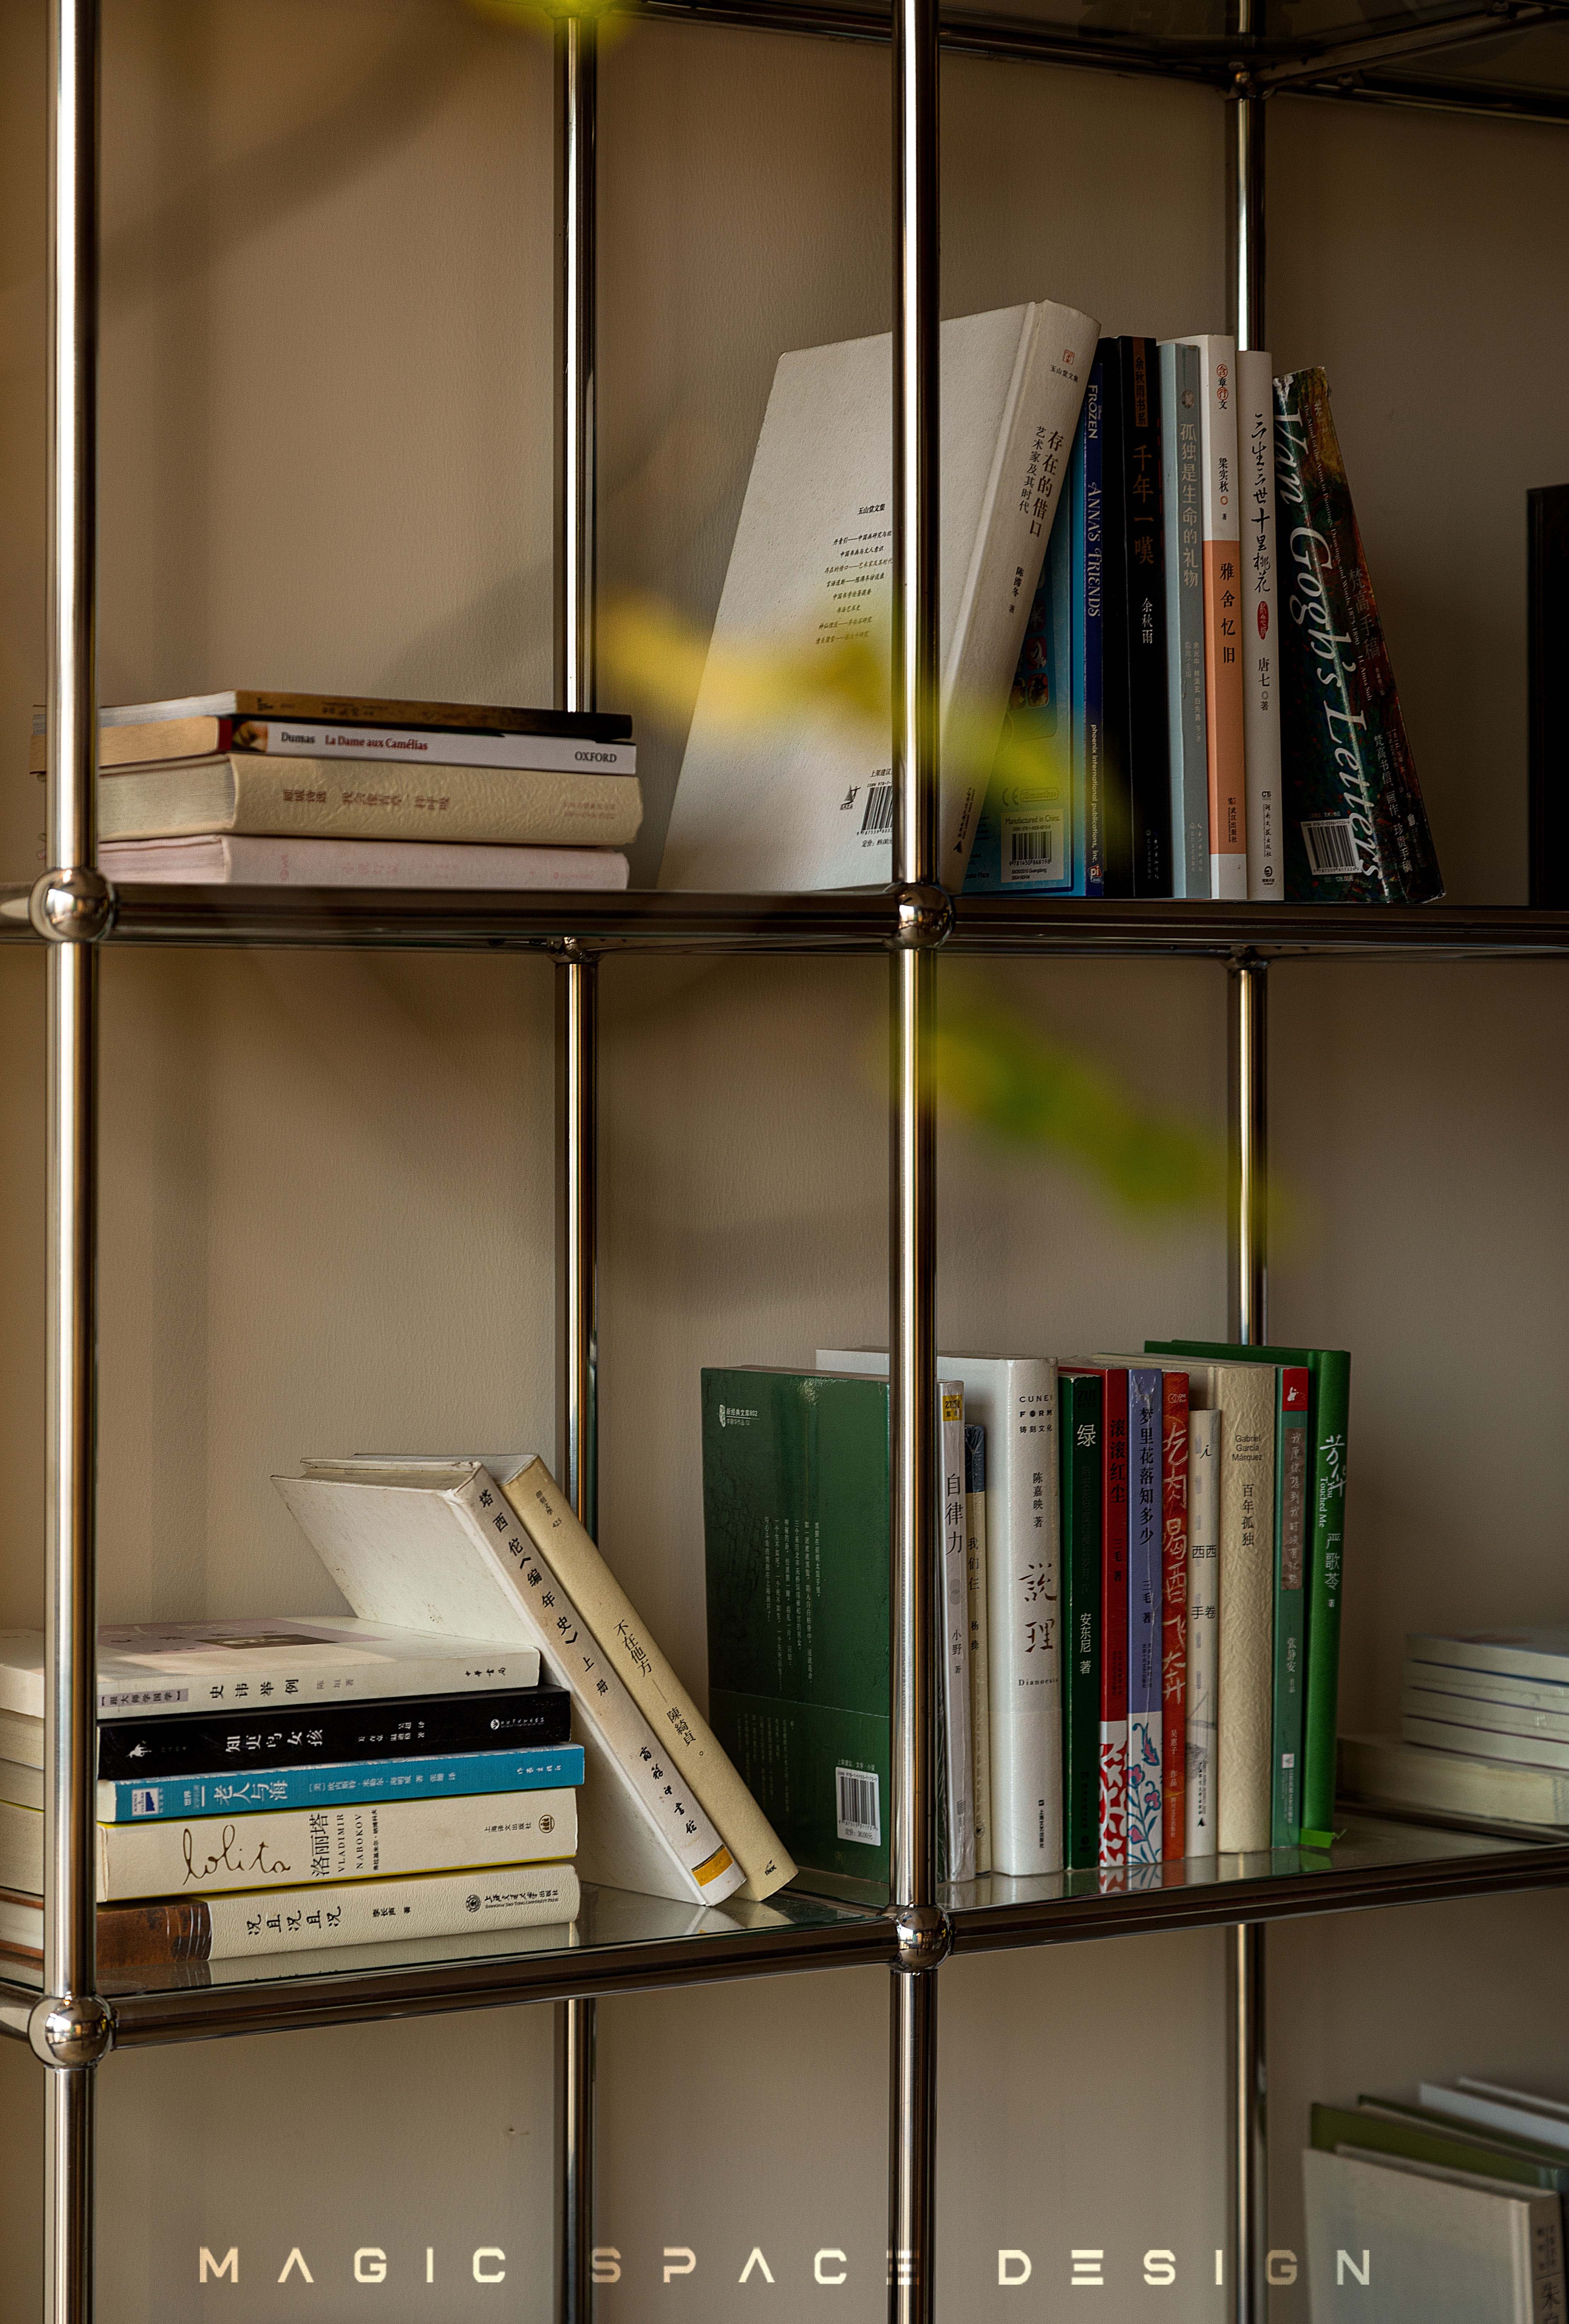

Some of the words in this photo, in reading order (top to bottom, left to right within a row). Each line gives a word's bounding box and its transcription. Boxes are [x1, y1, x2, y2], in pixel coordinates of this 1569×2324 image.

[1049, 365, 1078, 383] 玉山堂文集
[1217, 364, 1228, 410] 含章行文
[1135, 356, 1146, 425] 余秋雨书系
[1087, 384, 1098, 439] FROZEN
[1019, 426, 1046, 513] 艺术家及其时代
[1029, 430, 1063, 537] 存在的借口
[1218, 457, 1229, 492] 梁实秋
[858, 503, 885, 515] 玉山堂文集
[1180, 423, 1198, 587] 孤独是生命的礼物
[1251, 413, 1271, 594] 三生三世十里桃花
[1307, 418, 1316, 439] Mind
[1359, 667, 1370, 686] Anna
[1087, 547, 1101, 617] FRIENDS
[1009, 604, 1015, 613] 著
[1141, 597, 1153, 644] 余秋雨
[1219, 563, 1235, 664] 雅舍忆旧
[1348, 569, 1380, 660] 梵高手稿
[1275, 408, 1309, 505] Van
[1324, 700, 1383, 880] Letters
[1258, 657, 1270, 687] 唐七
[1260, 701, 1269, 711] 著
[281, 732, 315, 744] Dumas
[325, 734, 337, 745] La
[338, 736, 364, 746] Dame
[366, 739, 384, 748] aux
[385, 738, 428, 750] Camélias
[574, 751, 617, 762] OXFORD
[1091, 755, 1099, 802] international
[1019, 1394, 1052, 1403] CUNEI
[1020, 1425, 1052, 1433] 铸刻文化
[1077, 1424, 1096, 1448] 绿
[1235, 1435, 1261, 1443] Gabriel
[1110, 1418, 1127, 1504] 滚滚红尘
[1232, 1453, 1263, 1462] Márquez
[1236, 1444, 1259, 1452] García
[1033, 1472, 1043, 1510] 陈嘉映
[1139, 1406, 1154, 1546] 梦里花落知多少
[1320, 1477, 1329, 1512] Touched
[552, 1517, 562, 1529] 425
[946, 1473, 964, 1555] 自律力
[1033, 1517, 1043, 1528] 著
[1242, 1484, 1254, 1547] 百年孤独
[1319, 1515, 1326, 1528] Me
[967, 1537, 980, 1591] 我们仨
[1112, 1537, 1123, 1563] 三毛
[1192, 1545, 1216, 1558] 西西
[1325, 1533, 1341, 1590] 严歌苓
[1113, 1570, 1122, 1582] 著
[1142, 1580, 1152, 1604] 三毛
[1142, 1612, 1151, 1624] 著
[1191, 1606, 1216, 1619] 手卷
[952, 1629, 962, 1655] 小野
[1080, 1613, 1092, 1653] 安东尼
[1080, 1660, 1091, 1674] 著
[209, 1679, 299, 1699] 史讳举例
[613, 1619, 653, 1677] 不在他方
[666, 1707, 697, 1747] 陳綺貞
[516, 1764, 561, 1775] 作家出版社
[1170, 1770, 1178, 1787] 作品
[183, 1790, 192, 1806] 世界
[213, 1780, 289, 1805] 老人与海
[639, 1747, 697, 1835] 商务印书馆
[355, 1814, 363, 1869] NABOKOV
[484, 1822, 532, 1833] 上海译文出版社
[310, 1813, 330, 1878] 洛丽塔
[338, 1813, 346, 1873] VLADIMIR
[765, 1865, 777, 1876] INK
[484, 1889, 559, 1902] 上海交通大学出版社
[247, 1906, 342, 1935] 况且况且况
